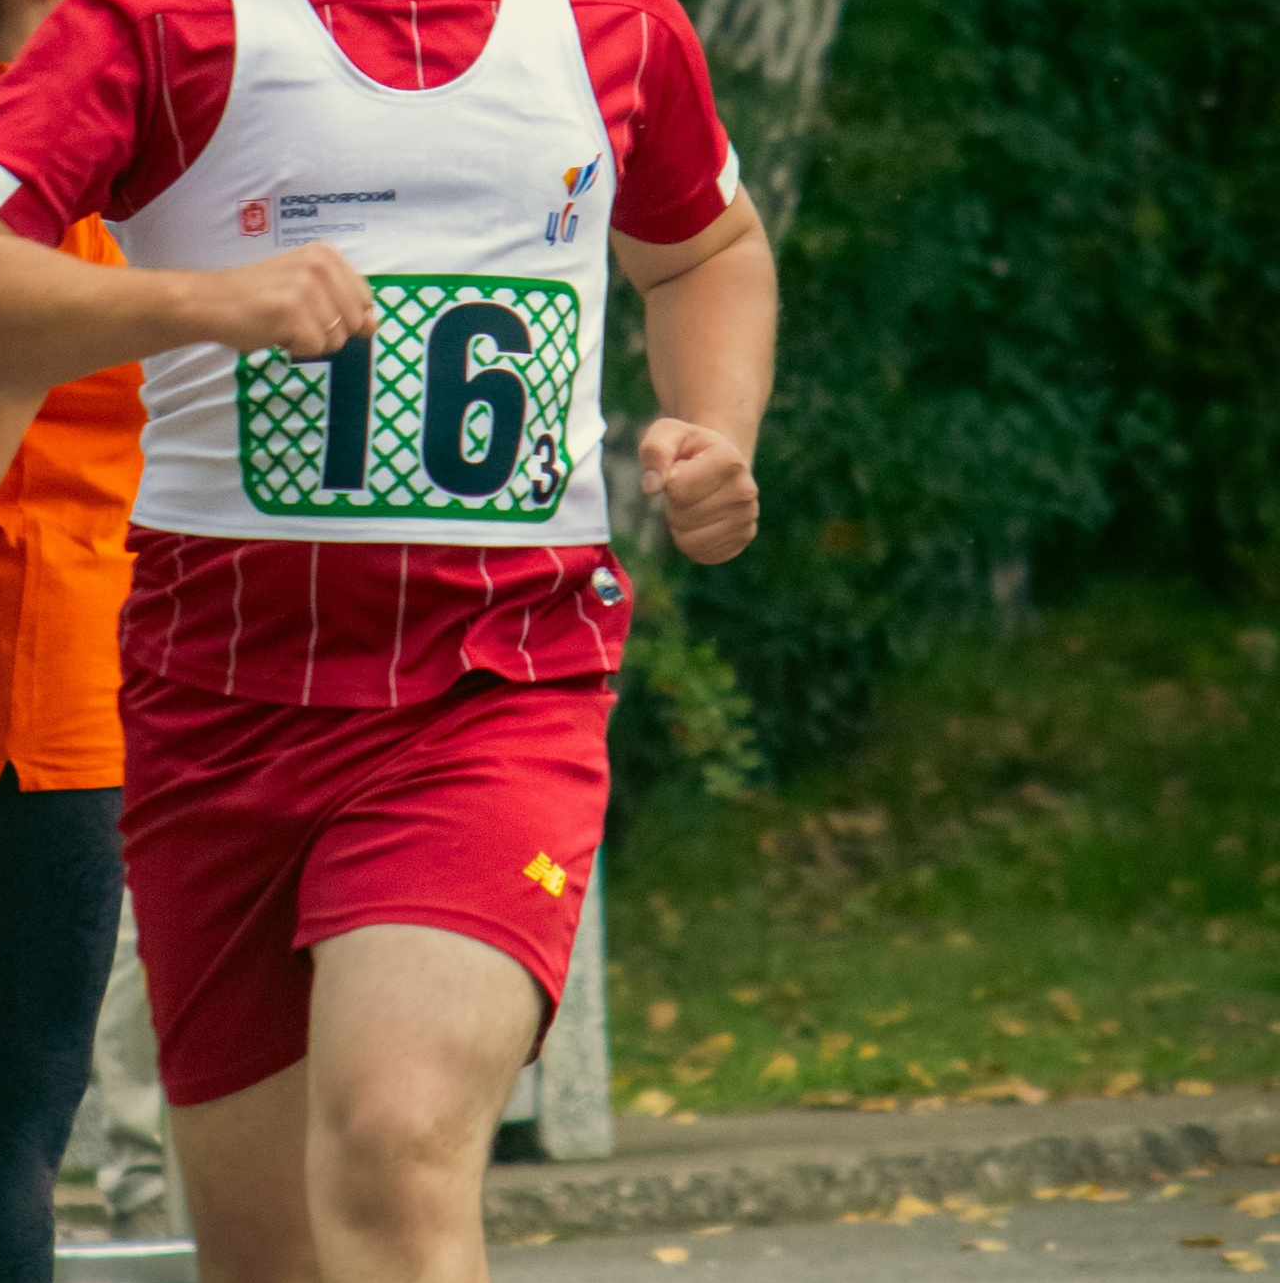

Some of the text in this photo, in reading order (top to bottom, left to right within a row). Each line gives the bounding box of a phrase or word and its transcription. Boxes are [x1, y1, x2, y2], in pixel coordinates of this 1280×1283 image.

[280, 189, 396, 206] КРАСНОЯРСКИЙ
[280, 205, 319, 219] КРАЙ
[290, 301, 533, 498] 16
[531, 433, 561, 505] 3
